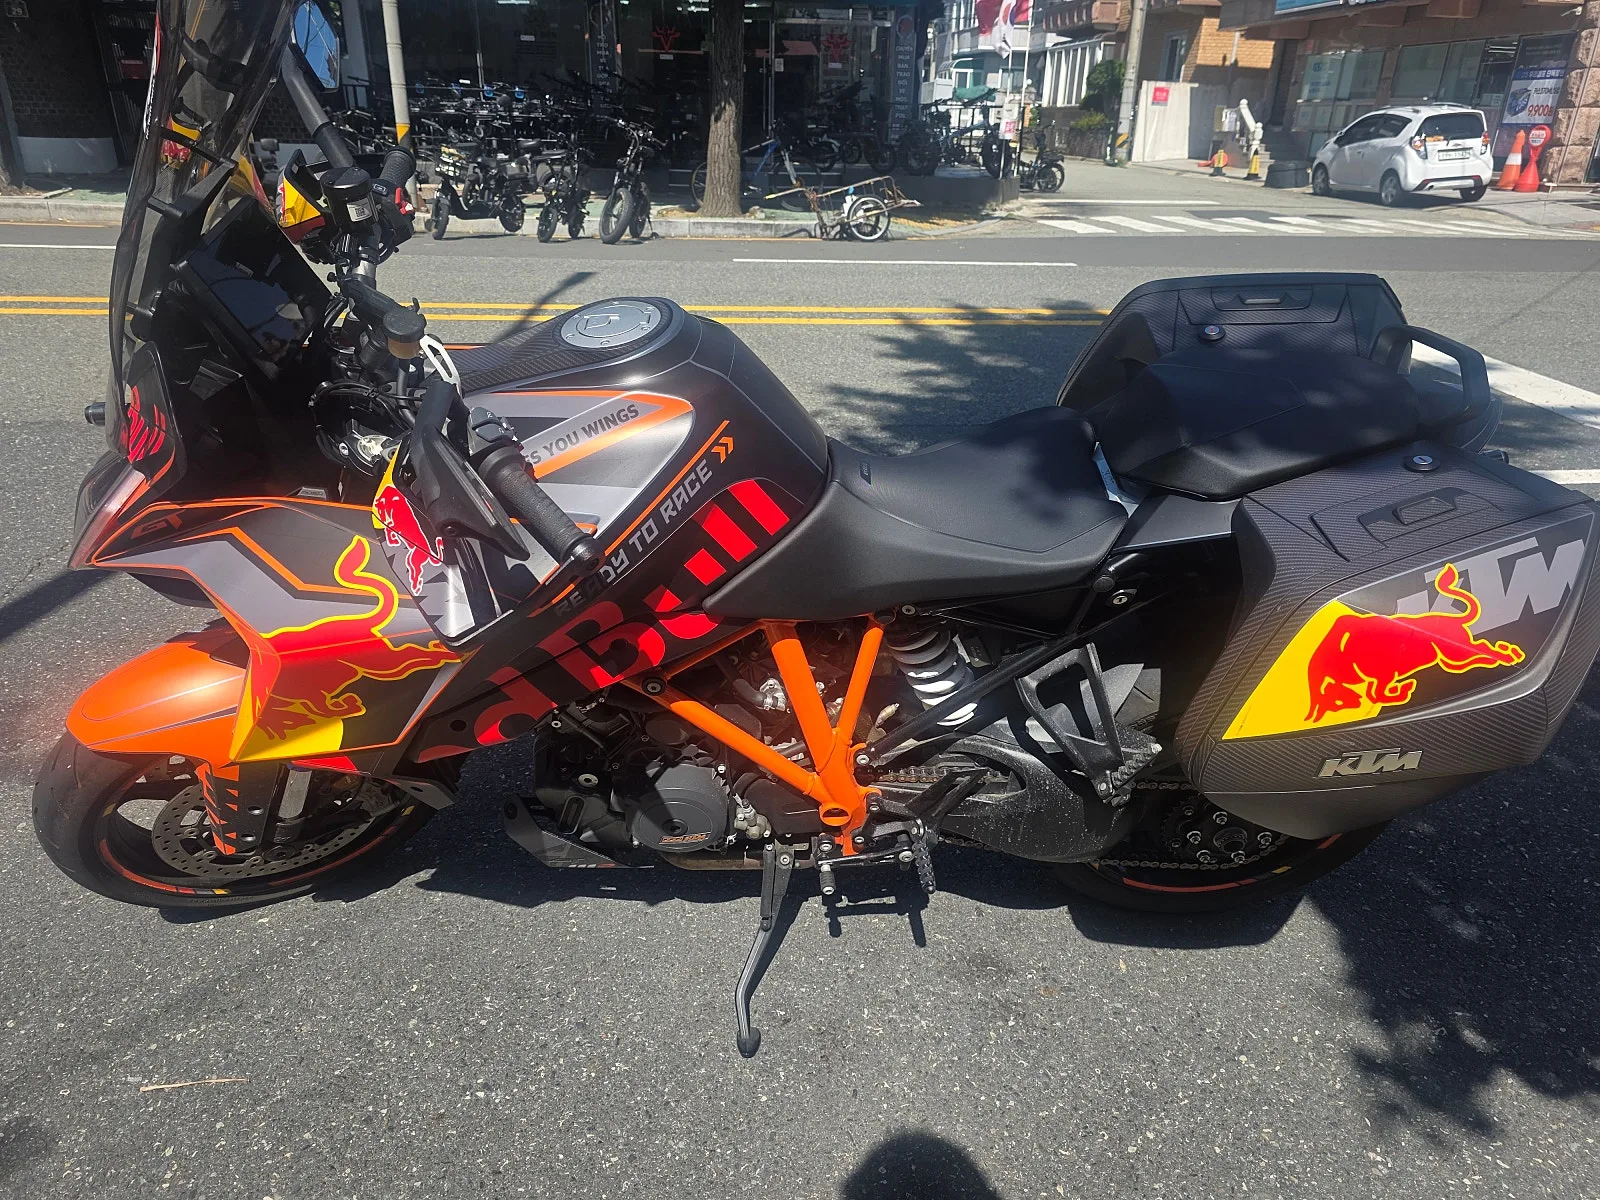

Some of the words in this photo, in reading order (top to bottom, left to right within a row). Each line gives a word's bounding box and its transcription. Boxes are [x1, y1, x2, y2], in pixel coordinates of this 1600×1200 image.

[543, 430, 581, 457] YOU
[581, 404, 639, 439] WINGS
[131, 511, 185, 539] GT
[629, 518, 660, 554] TO
[659, 459, 714, 525] RACE
[1318, 747, 1424, 779] KTM
